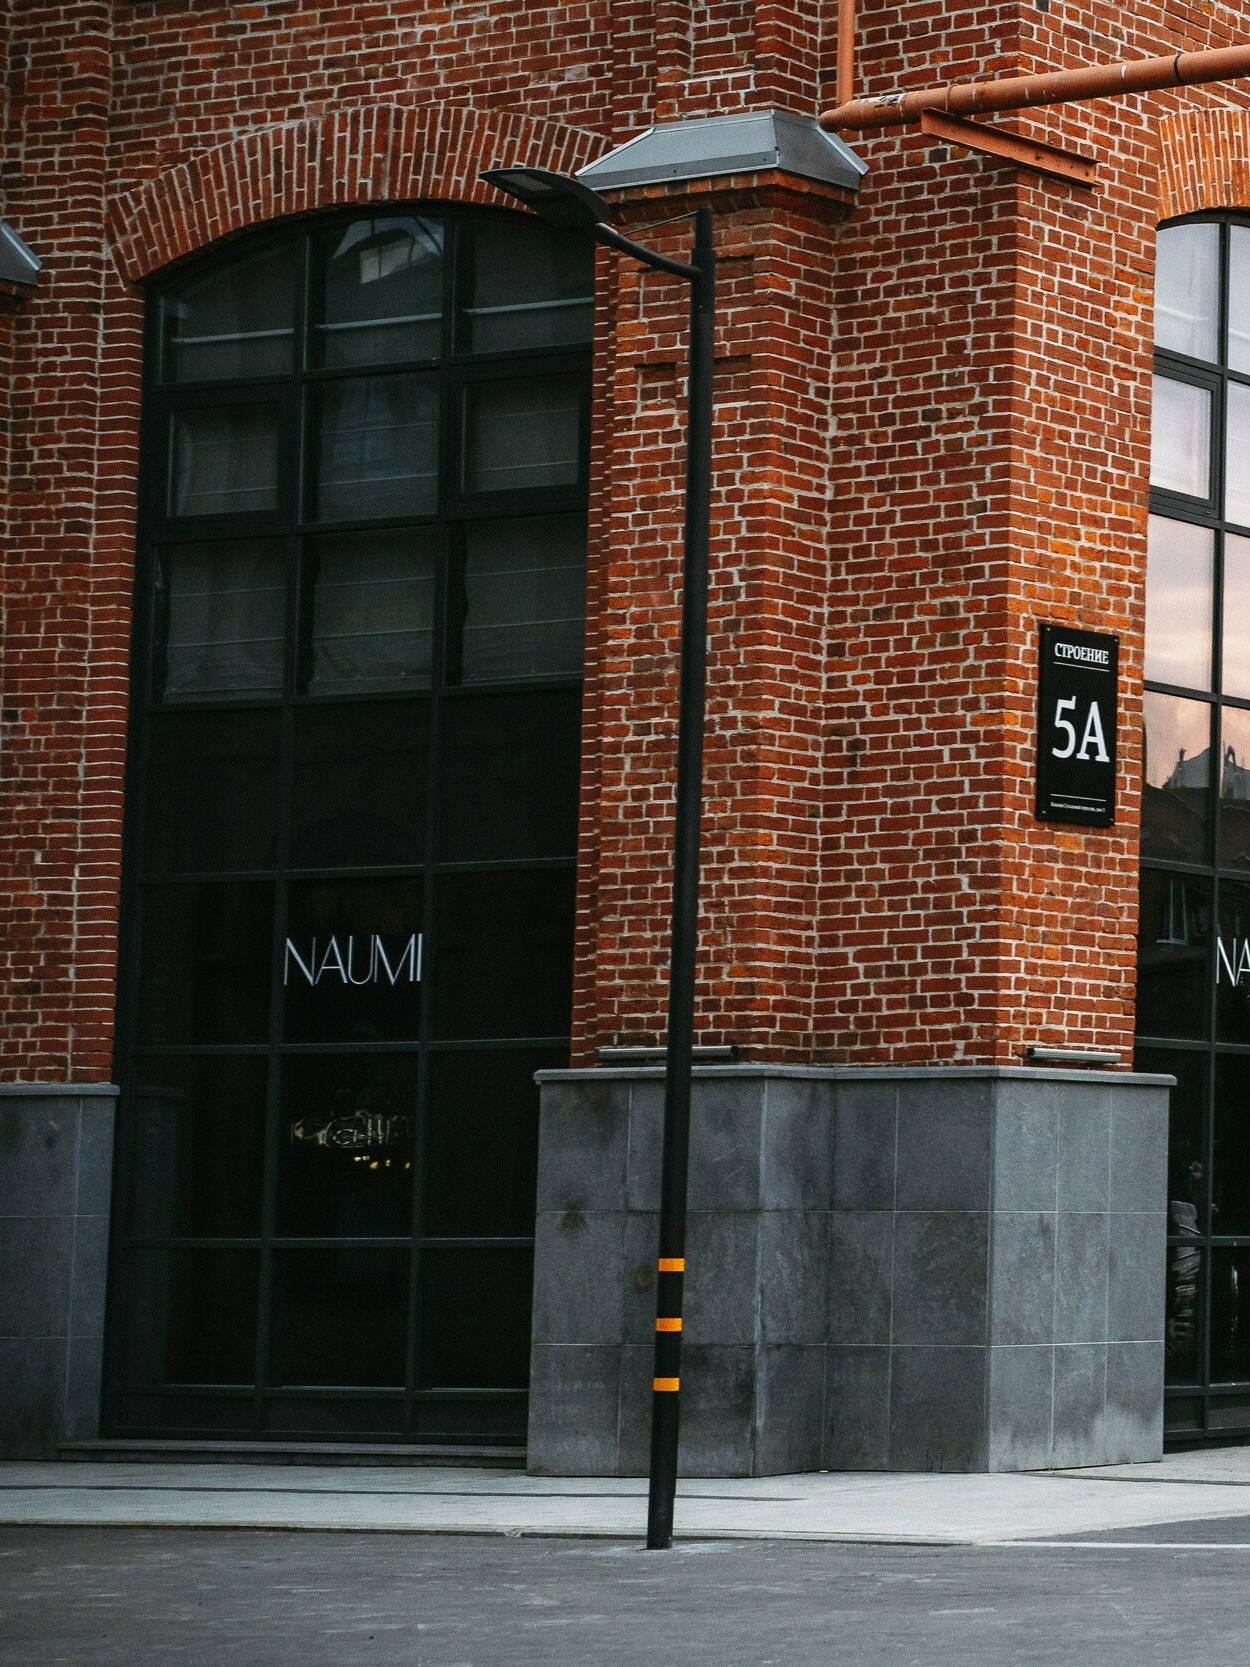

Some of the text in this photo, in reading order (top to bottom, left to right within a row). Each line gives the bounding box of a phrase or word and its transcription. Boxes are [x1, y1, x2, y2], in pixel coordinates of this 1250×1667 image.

[1054, 642, 1109, 665] СТРОЕНИЕ
[1051, 695, 1110, 763] 5А
[283, 933, 423, 986] NAUMI
